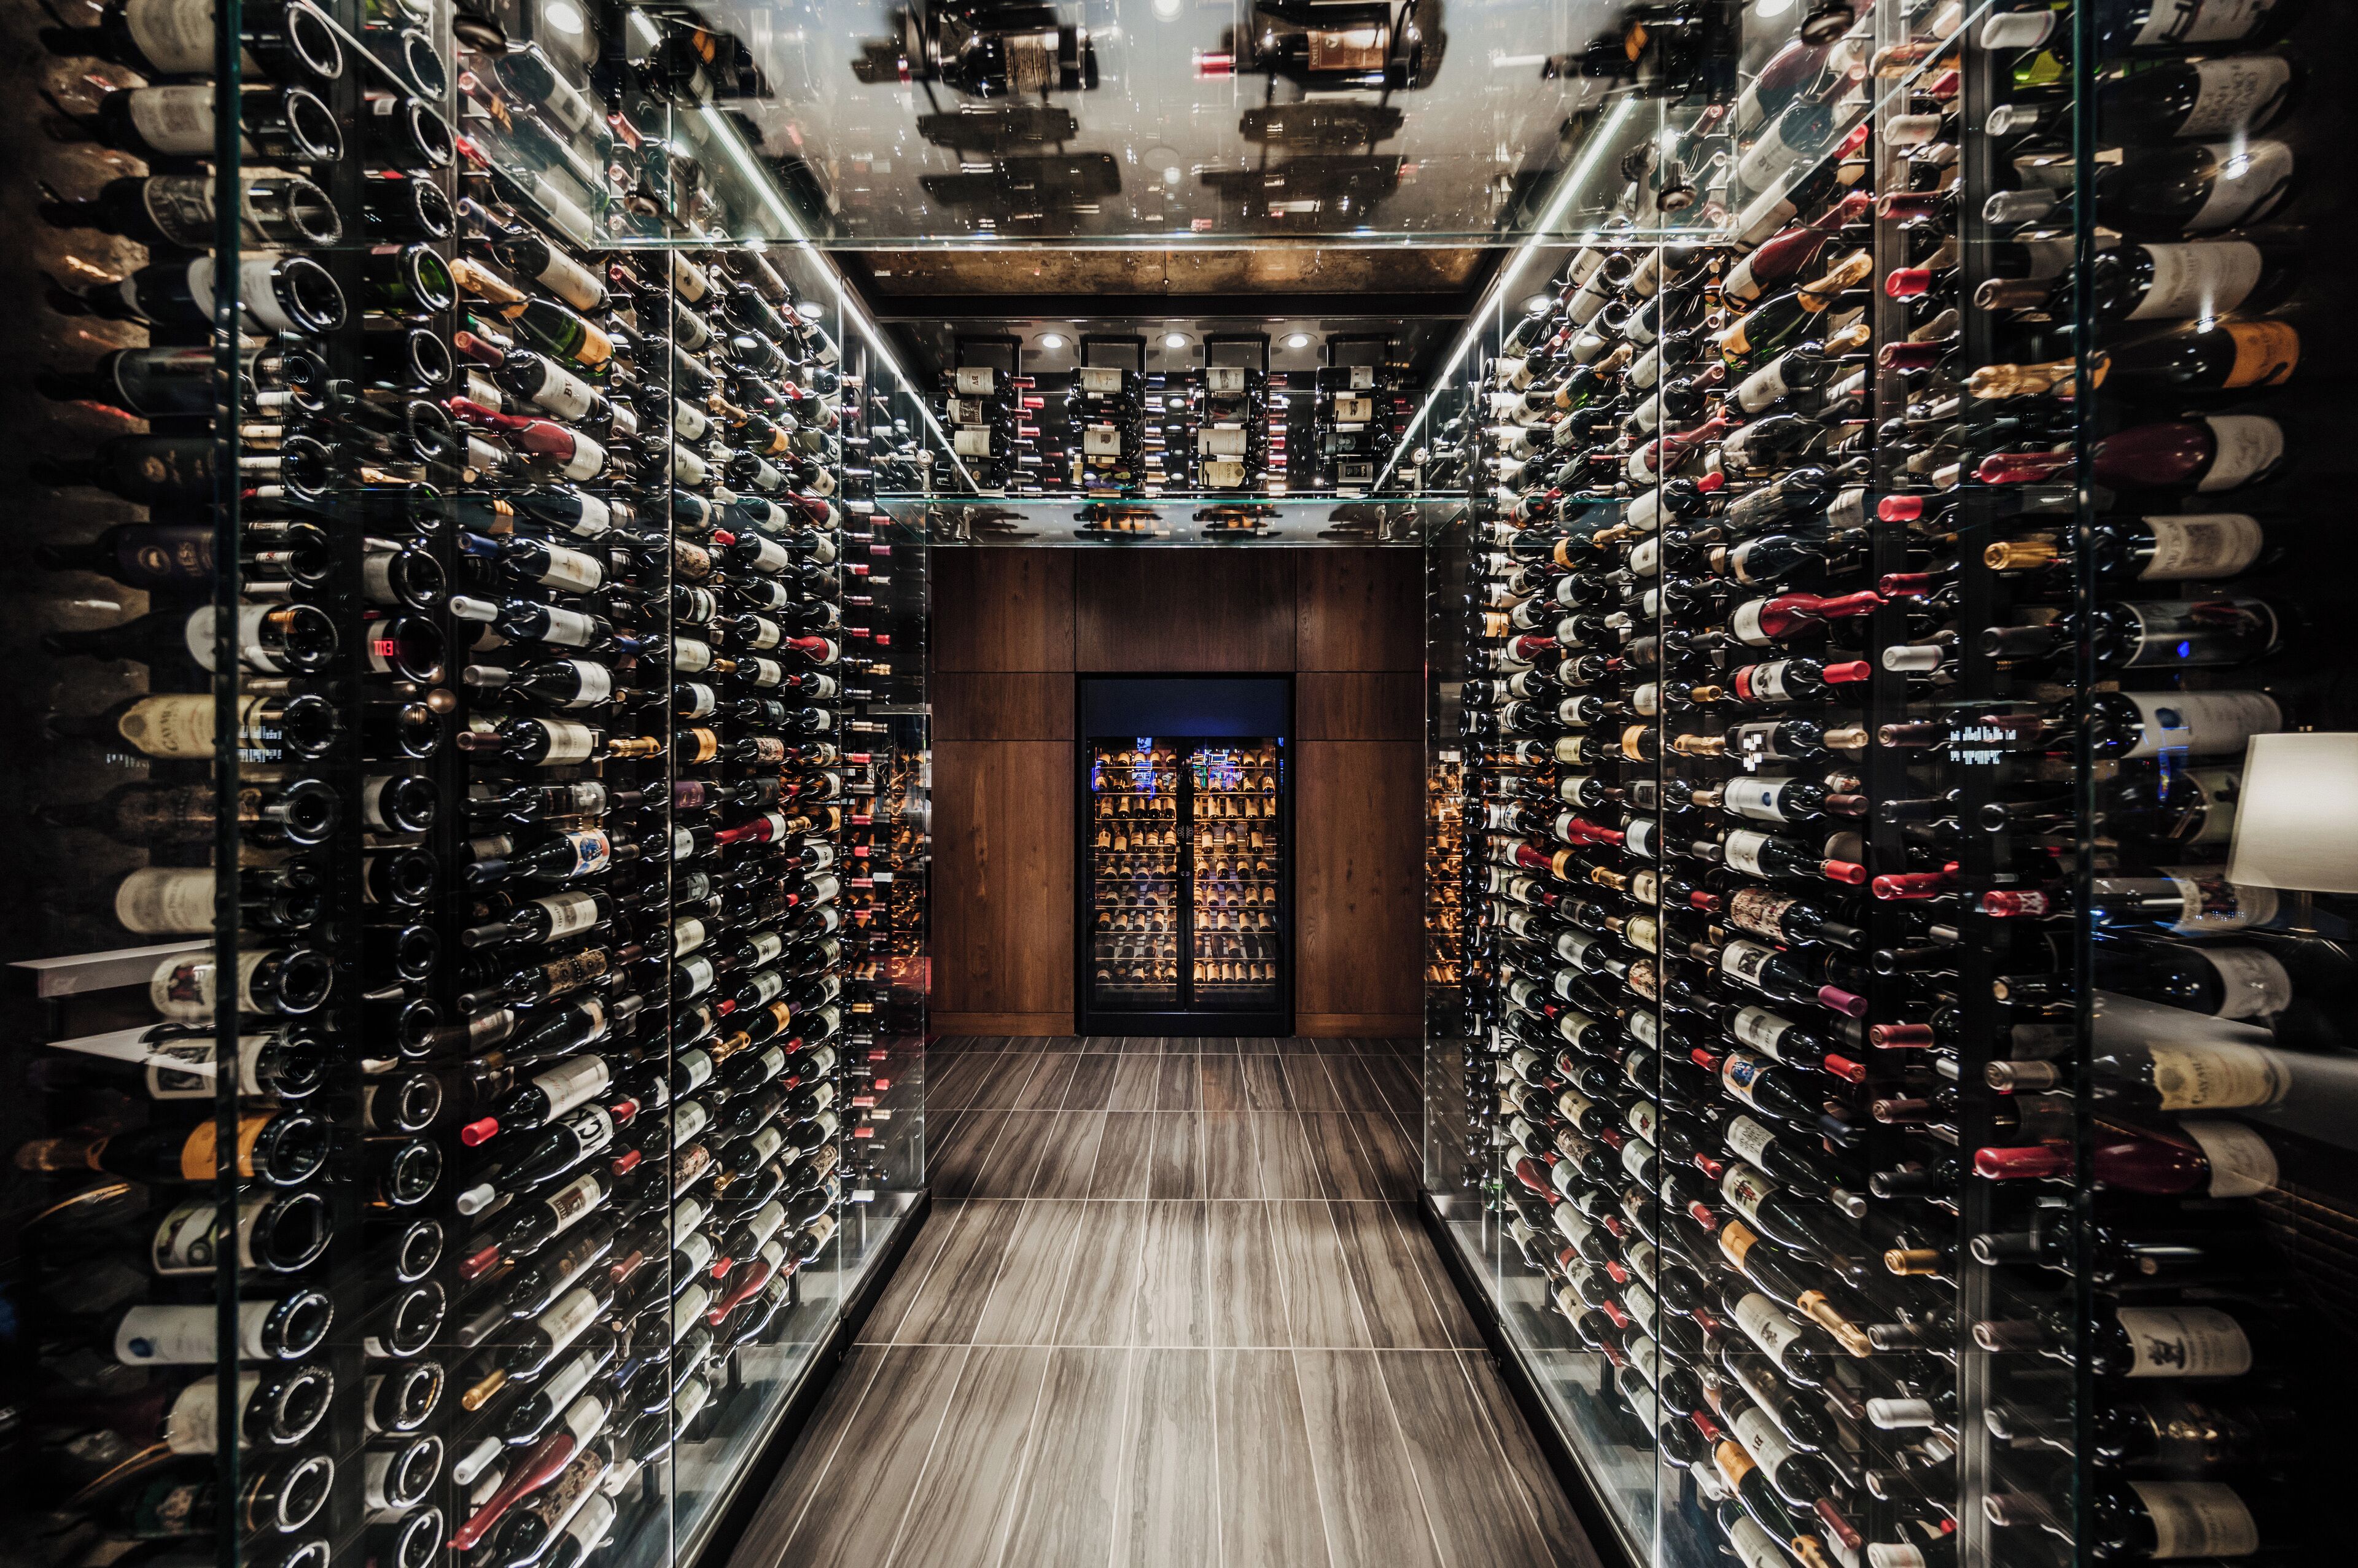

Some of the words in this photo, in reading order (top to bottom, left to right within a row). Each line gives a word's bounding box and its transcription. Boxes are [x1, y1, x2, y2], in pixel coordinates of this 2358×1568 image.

[972, 376, 979, 386] BV
[564, 379, 573, 398] BV
[1518, 1057, 1525, 1067] BV
[1753, 1434, 1763, 1453] BV
